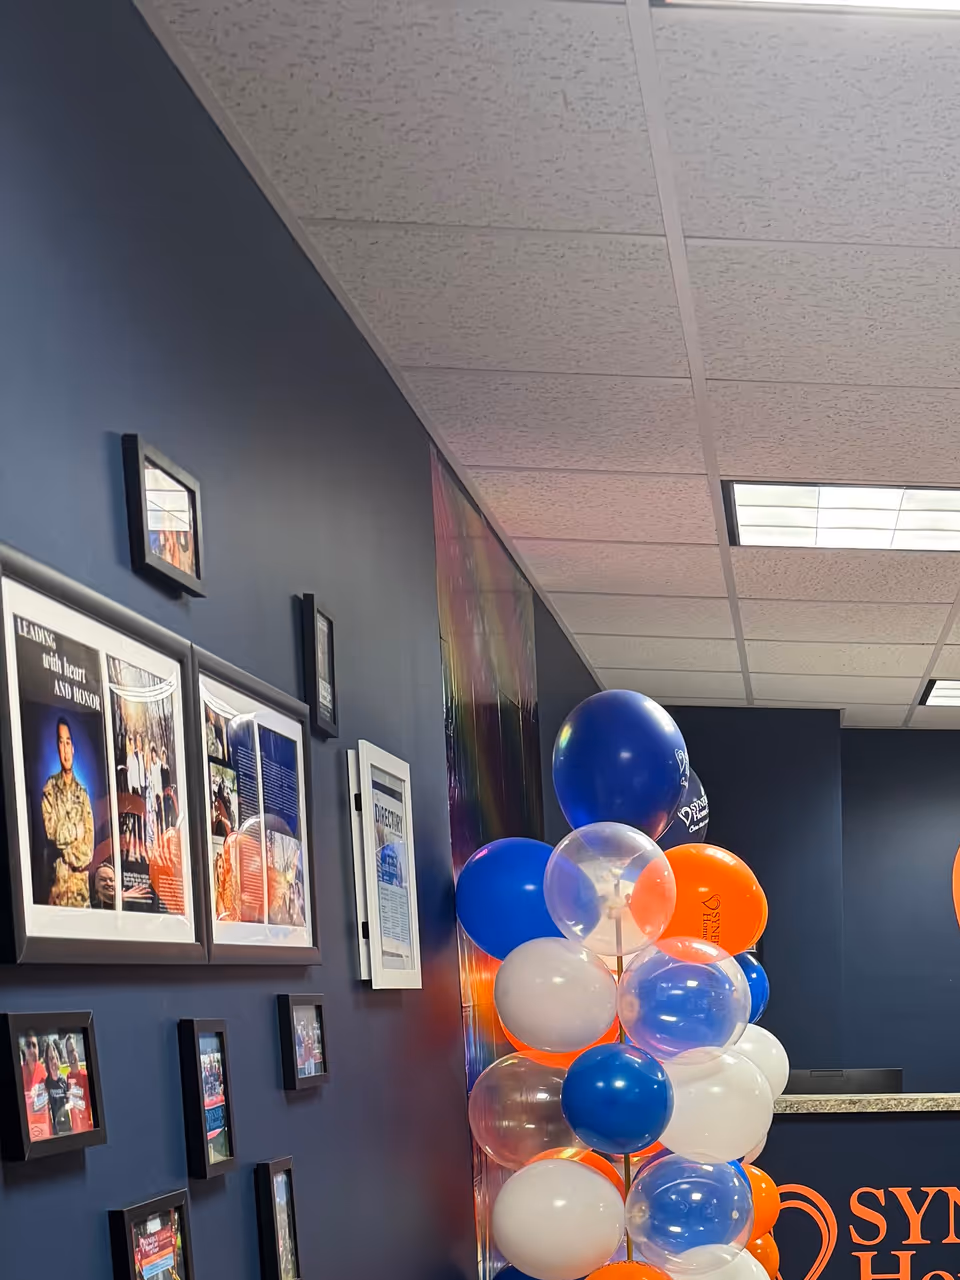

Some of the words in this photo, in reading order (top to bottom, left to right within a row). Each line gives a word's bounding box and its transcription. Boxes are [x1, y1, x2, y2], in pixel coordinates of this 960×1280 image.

[17, 617, 57, 650] LEADING
[43, 651, 63, 674] with
[64, 656, 87, 684] heart
[54, 679, 72, 700] AND
[73, 684, 101, 711] HONOR
